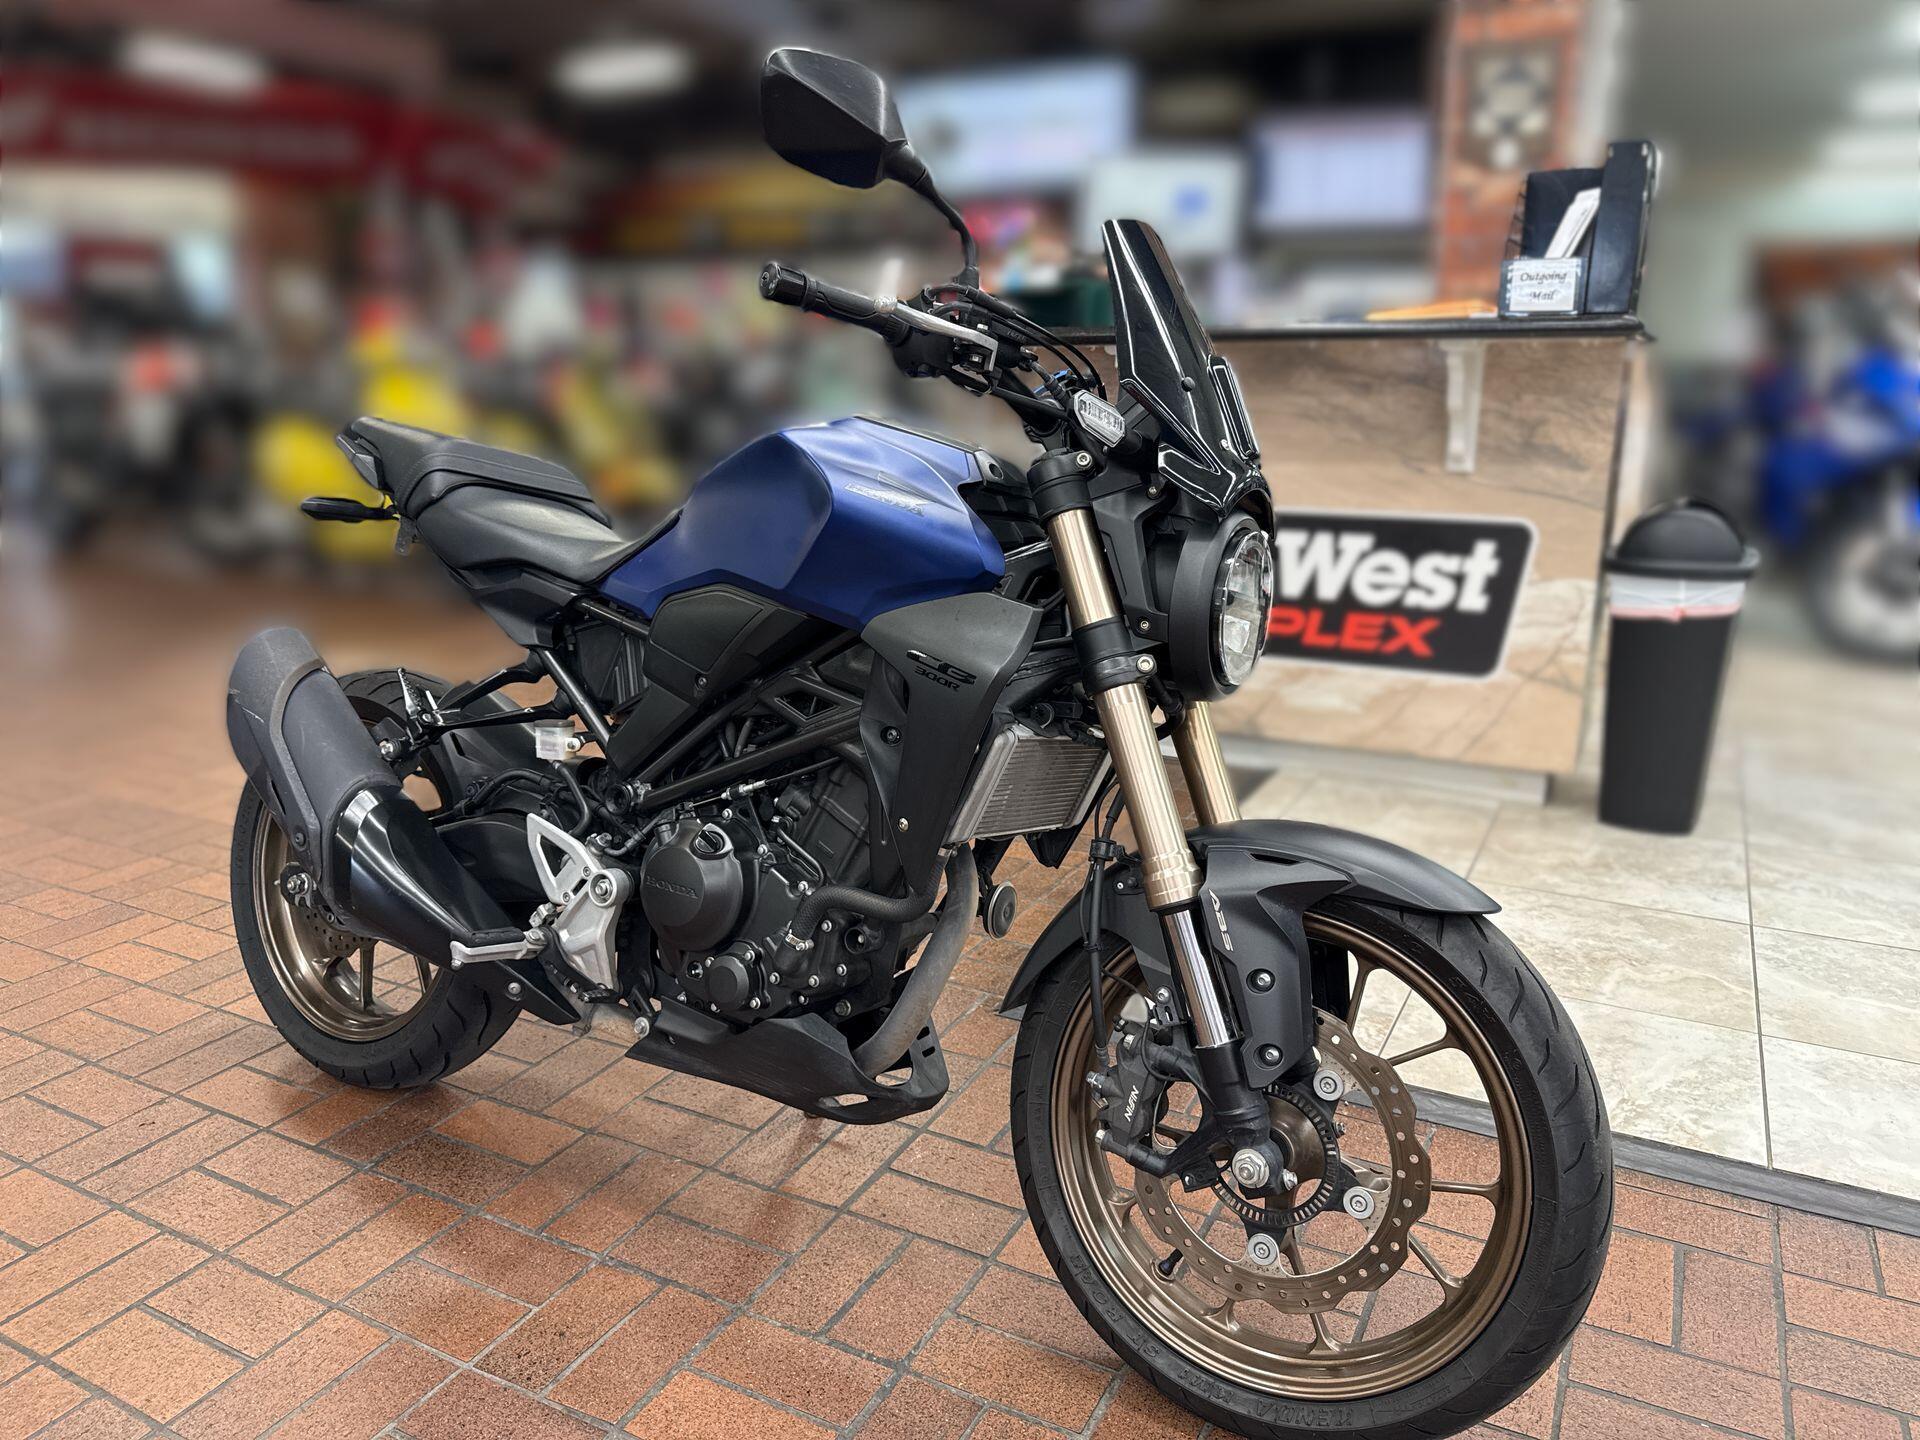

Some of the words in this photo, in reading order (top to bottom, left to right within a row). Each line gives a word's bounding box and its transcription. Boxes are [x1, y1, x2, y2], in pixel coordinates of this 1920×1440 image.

[1520, 271, 1568, 284] Outgoing
[1530, 290, 1560, 301] Mail
[1274, 529, 1500, 614] West
[1266, 606, 1442, 658] PLEX
[906, 650, 977, 685] CB
[913, 665, 961, 692] 300R
[645, 875, 699, 900] HONDA
[1208, 889, 1234, 952] ABS
[1255, 1399, 1352, 1427] KENDA
